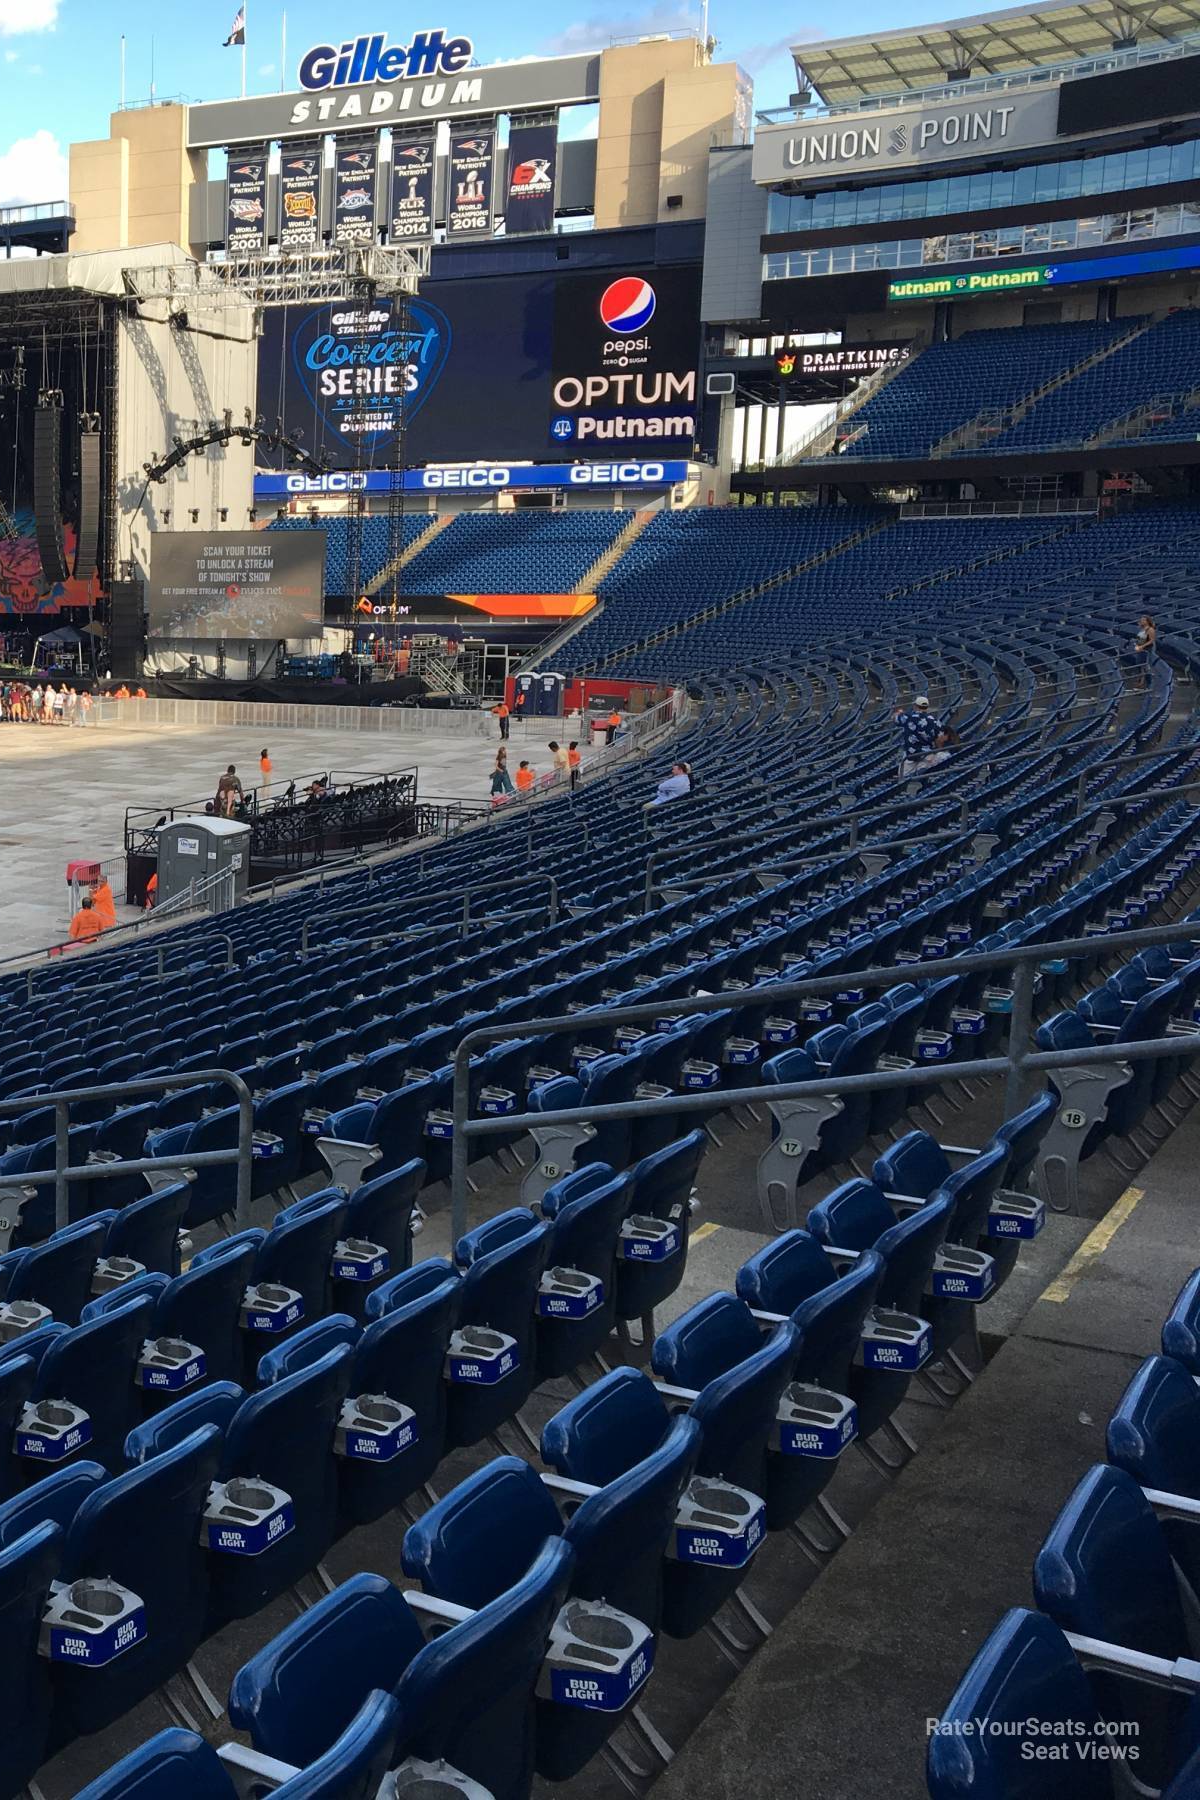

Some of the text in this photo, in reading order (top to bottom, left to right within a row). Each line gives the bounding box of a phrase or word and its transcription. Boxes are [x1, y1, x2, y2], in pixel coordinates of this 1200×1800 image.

[299, 28, 473, 91] Gillette
[290, 78, 482, 124] STADIUM
[788, 106, 1015, 165] UNION POINT
[457, 162, 486, 170] PATRIOTS
[287, 181, 314, 189] PATRIOTS
[511, 182, 552, 193] CHAMPIONS
[450, 210, 488, 219] CHAMPIONS
[393, 216, 430, 225] CHAMPIONS
[453, 217, 486, 229] 2016
[337, 222, 372, 230] CHAMPIONS
[395, 223, 427, 236] 2014
[229, 232, 263, 240] CHAMPIONS
[282, 233, 315, 245] 2003
[337, 229, 372, 241] 2004
[230, 239, 261, 250] 2001
[970, 270, 1039, 289] Putnam
[804, 348, 910, 365] DRAFTKINGS
[554, 371, 695, 408] OPTUM
[577, 416, 694, 439] Putnam
[570, 463, 664, 482] GEICO
[286, 473, 367, 491] GEICO
[423, 469, 510, 487] GEICO
[203, 546, 271, 556] SCAN YOUR TICKET
[196, 559, 274, 569] TO UNLOCK A STREAM
[199, 572, 270, 582] OF TONIGHT'S SHOW
[1067, 1113, 1081, 1124] 18
[785, 1142, 798, 1152] 17
[544, 1164, 555, 1176] 16
[1000, 1220, 1018, 1228] BUD
[945, 1278, 965, 1286] BUD
[942, 1284, 969, 1293] LIGHT
[547, 1304, 570, 1312] LIGHT
[550, 1300, 567, 1310] BUD
[873, 1354, 904, 1363] LIGHT
[458, 1370, 482, 1378] LIGHT
[461, 1364, 479, 1374] BUD
[152, 1372, 167, 1381] BUD
[149, 1378, 170, 1386] LIGHT
[358, 1438, 376, 1447] BUD
[796, 1433, 819, 1442] BUD
[27, 1440, 43, 1448] BUD
[791, 1440, 823, 1450] LIGHT
[24, 1445, 46, 1454] LIGHT
[354, 1445, 380, 1455] LIGHT
[269, 1514, 284, 1530] BUD
[221, 1531, 242, 1540] BUD
[267, 1520, 286, 1541] LIGHT
[218, 1539, 246, 1548] LIGHT
[693, 1538, 719, 1548] BUD
[689, 1545, 724, 1557] LIGHT
[117, 1620, 135, 1638] BUD
[64, 1638, 87, 1648] BUD
[114, 1627, 138, 1650] LIGHT
[60, 1646, 91, 1658] LIGHT
[569, 1679, 599, 1690] BUD
[565, 1688, 604, 1701] LIGHT
